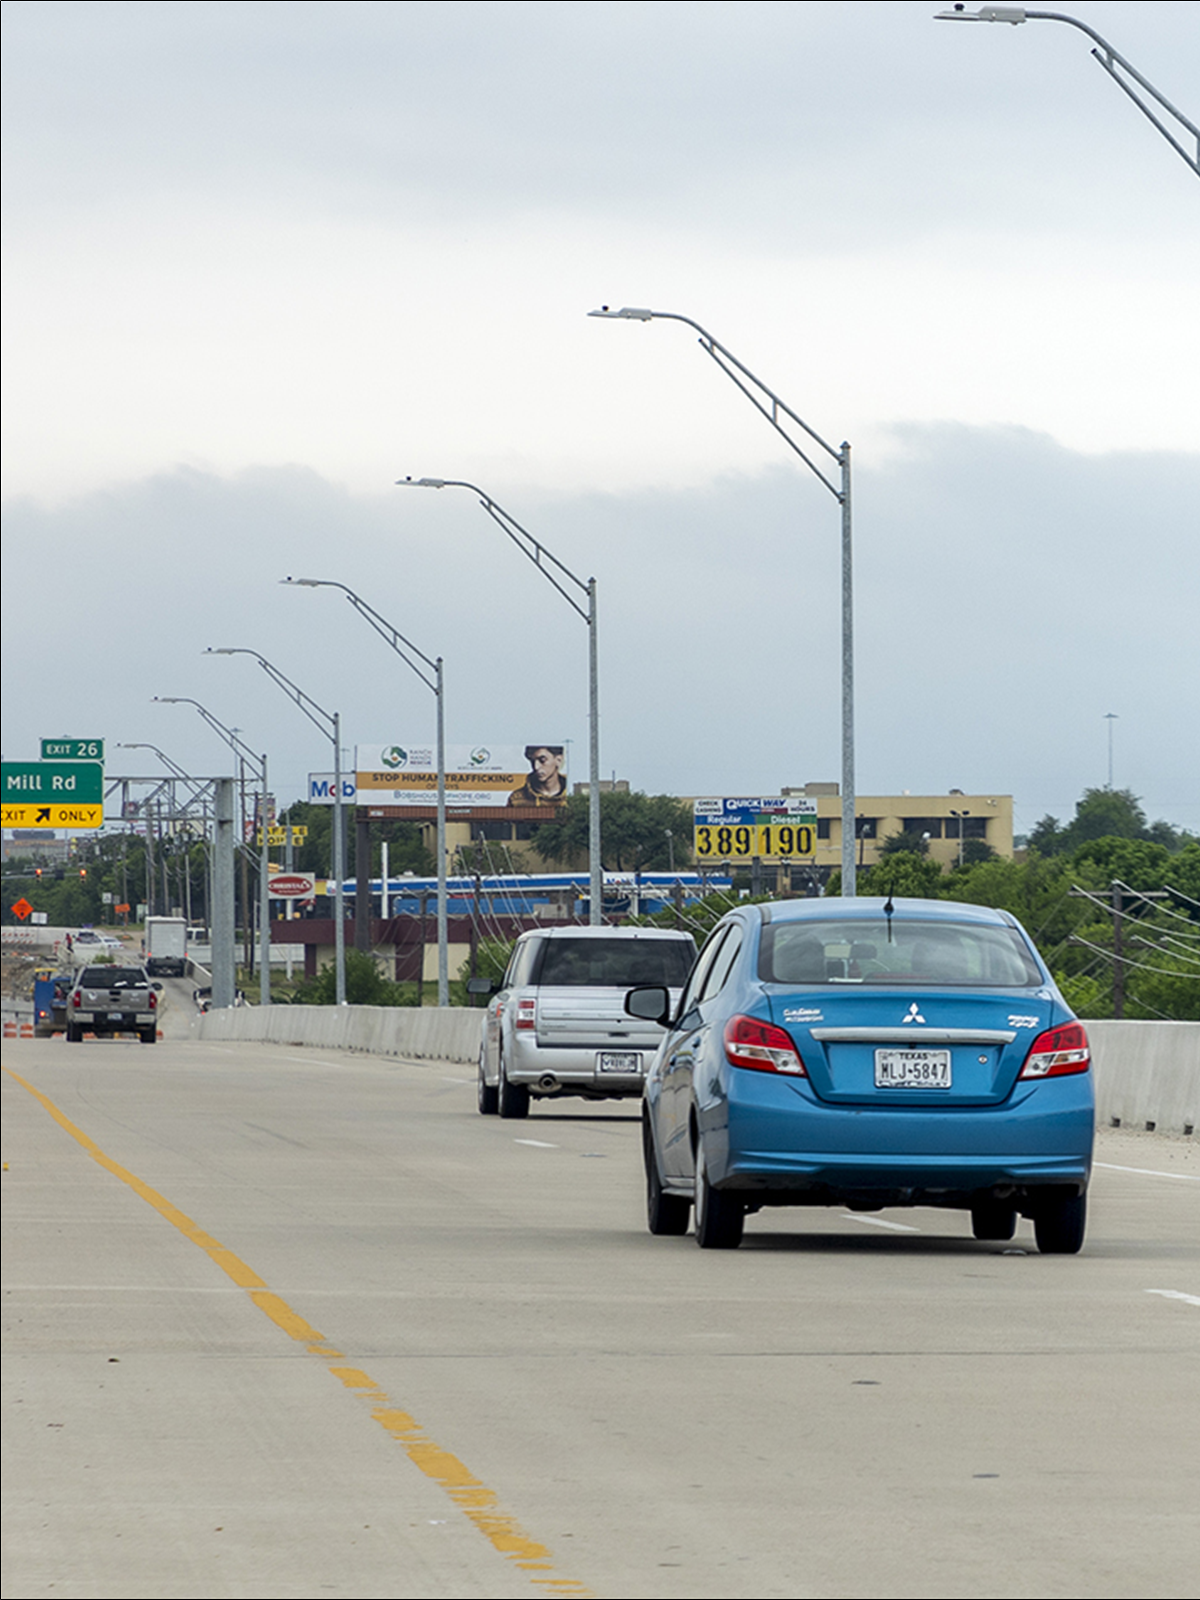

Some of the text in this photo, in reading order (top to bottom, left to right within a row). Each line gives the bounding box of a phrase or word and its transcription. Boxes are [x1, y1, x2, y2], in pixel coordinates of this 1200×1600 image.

[46, 742, 98, 757] EXIT 26
[7, 774, 76, 790] Mill Rd
[373, 773, 400, 782] STOP
[444, 774, 514, 783] TRAFFICKING
[762, 799, 788, 807] WAY
[58, 810, 96, 821] ONLY
[706, 815, 742, 825] Regular
[770, 815, 800, 824] Diesel
